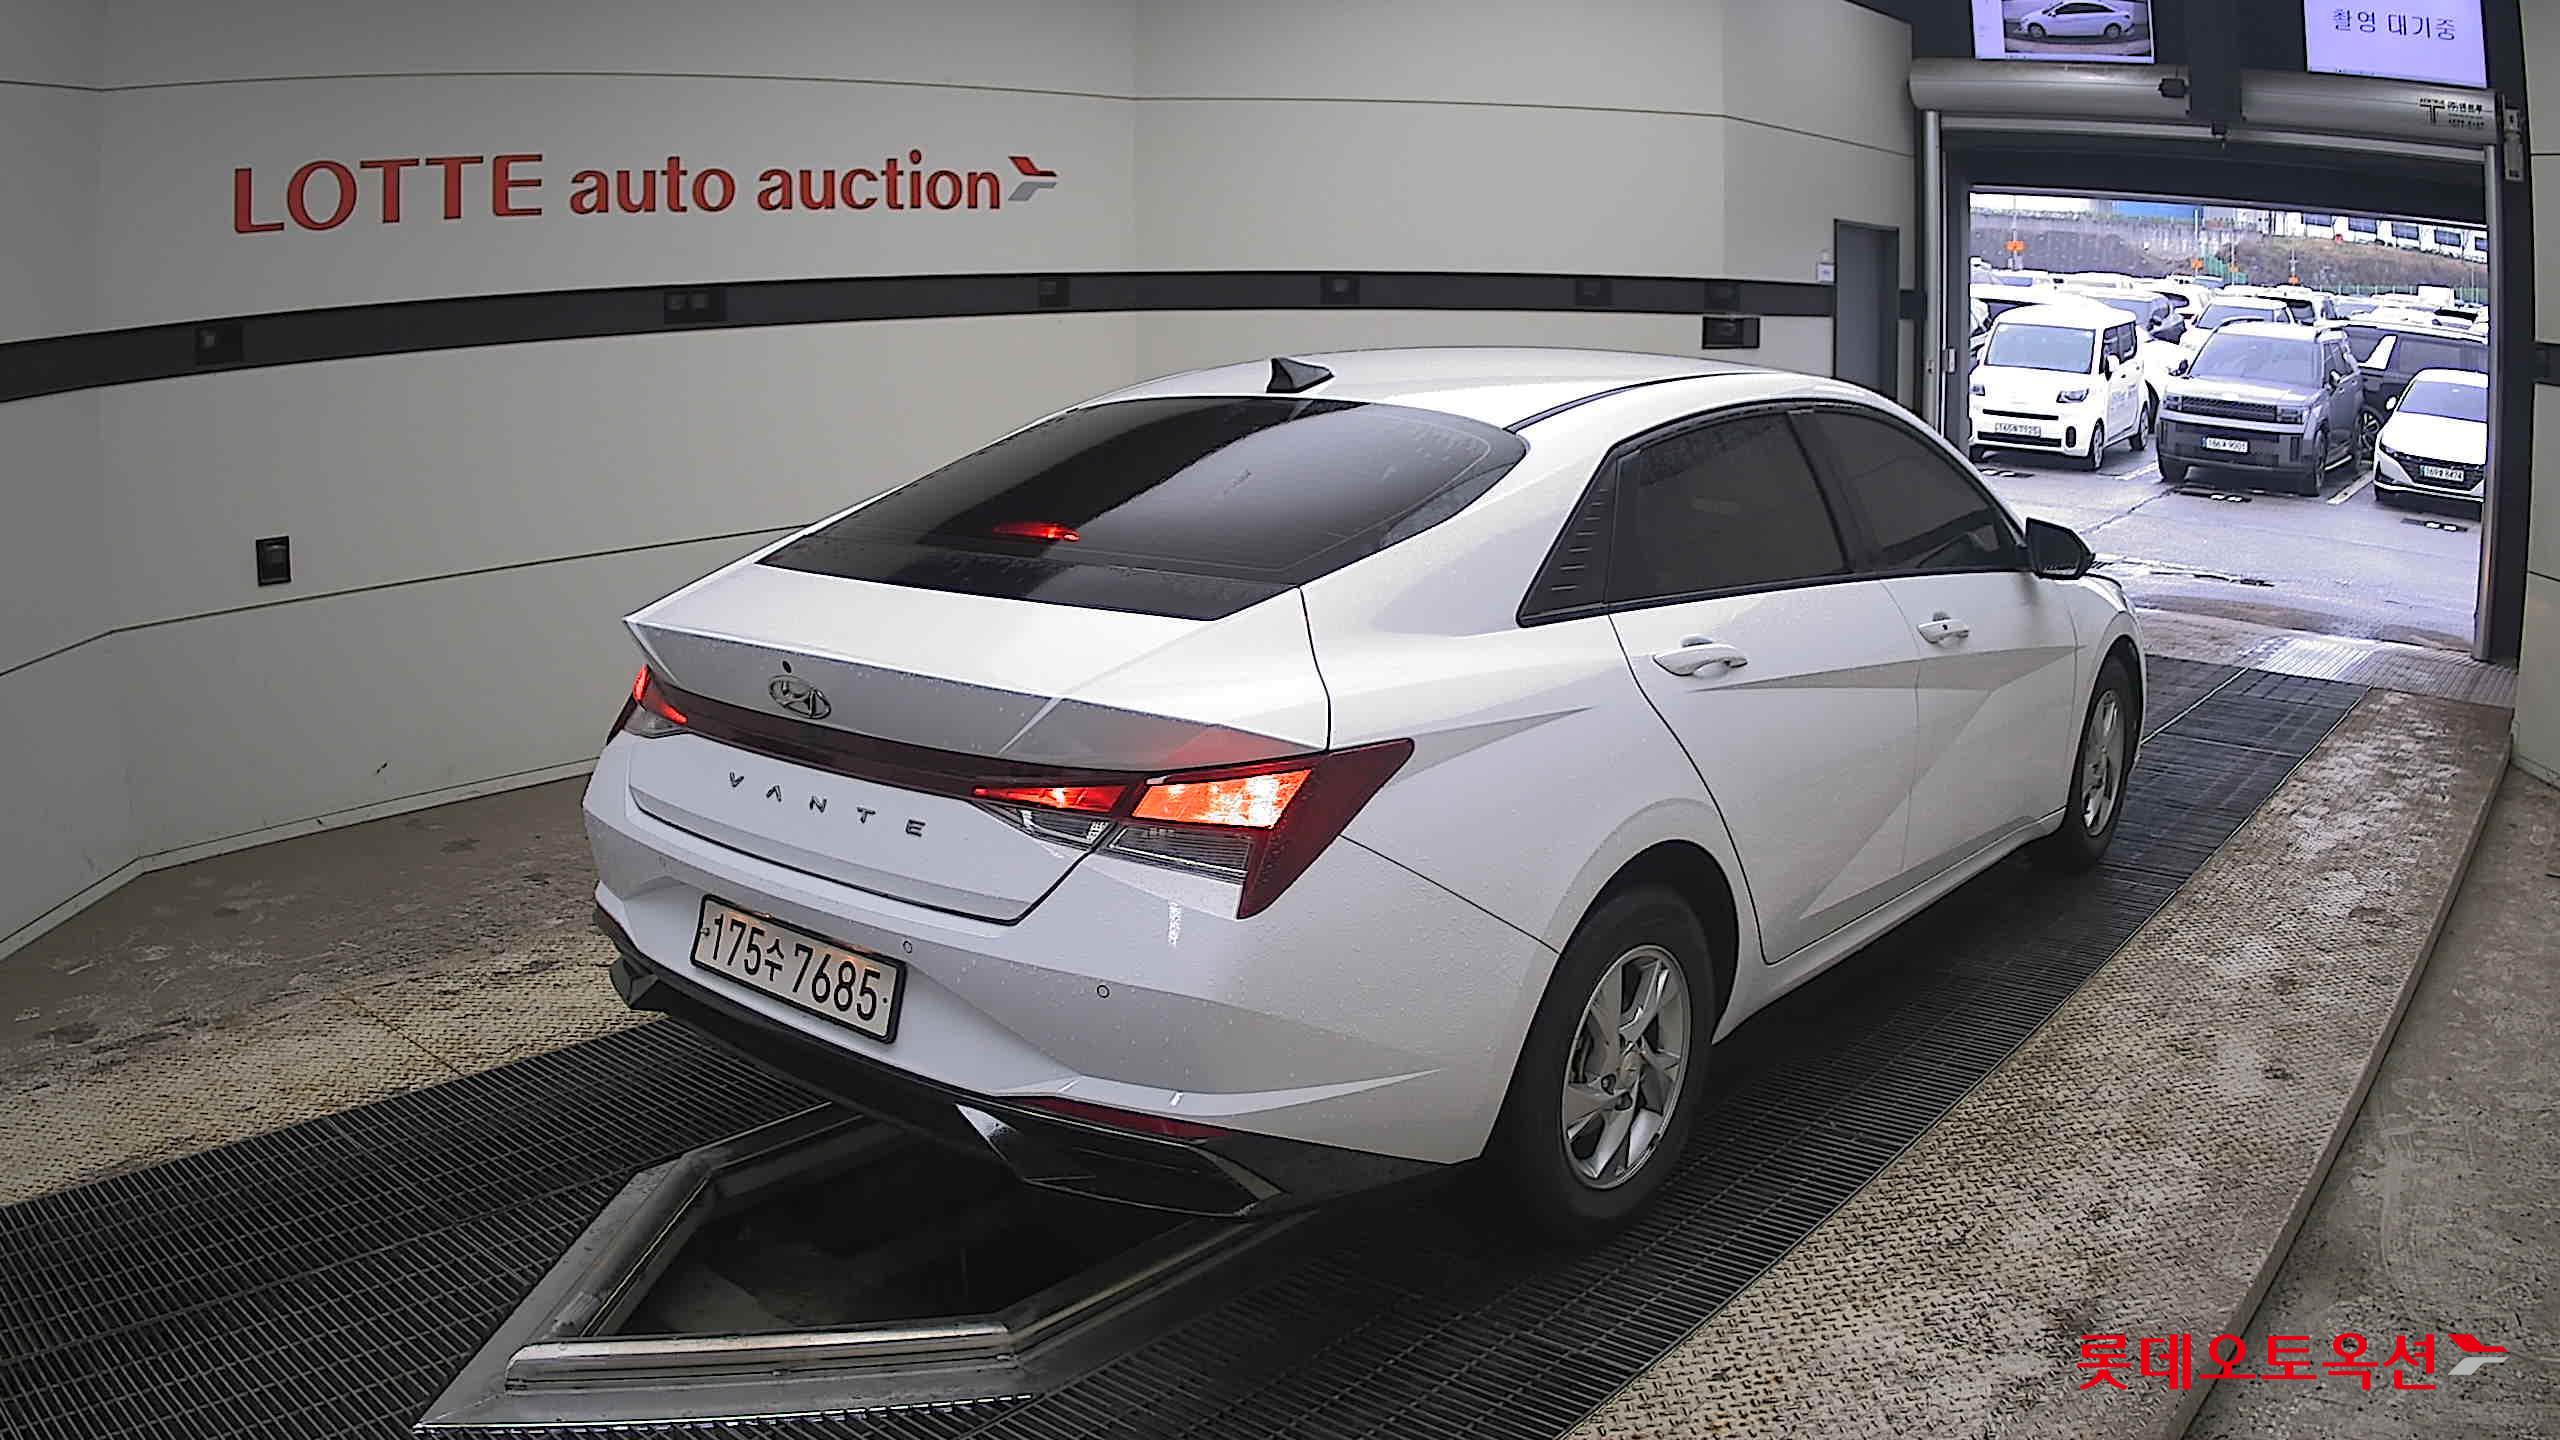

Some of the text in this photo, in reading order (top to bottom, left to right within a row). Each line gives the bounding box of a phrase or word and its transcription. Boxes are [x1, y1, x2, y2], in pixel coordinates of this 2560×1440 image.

[2330, 8, 2456, 41] 촬영 대기중
[234, 149, 1001, 234] LOTTE auto auction
[729, 771, 926, 838] VANTE
